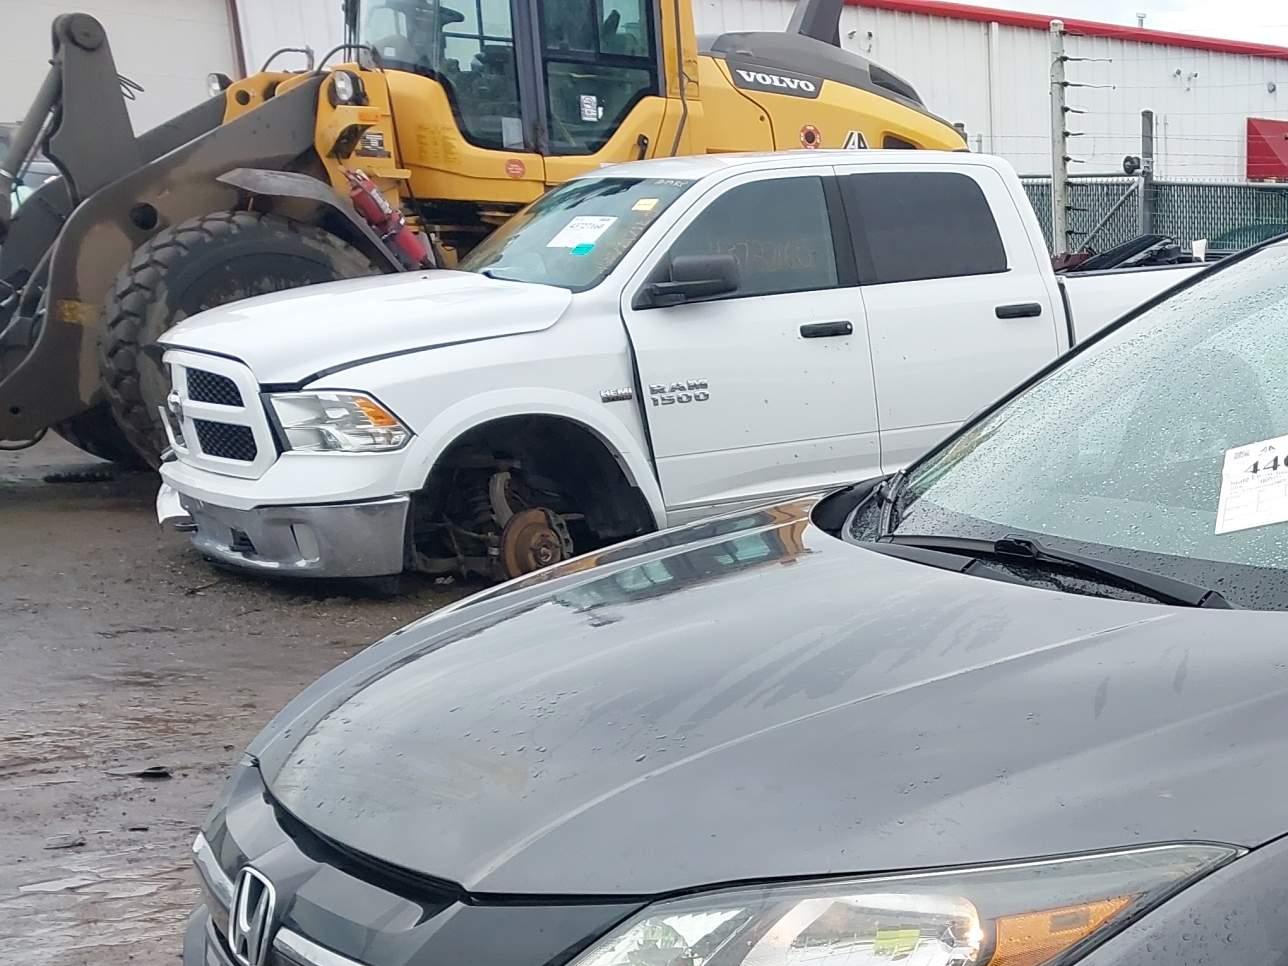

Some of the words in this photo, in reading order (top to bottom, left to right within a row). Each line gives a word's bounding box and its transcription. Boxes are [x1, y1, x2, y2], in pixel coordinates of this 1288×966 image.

[736, 69, 816, 92] VOLVO
[649, 380, 709, 395] RAM
[650, 391, 709, 406] 1500
